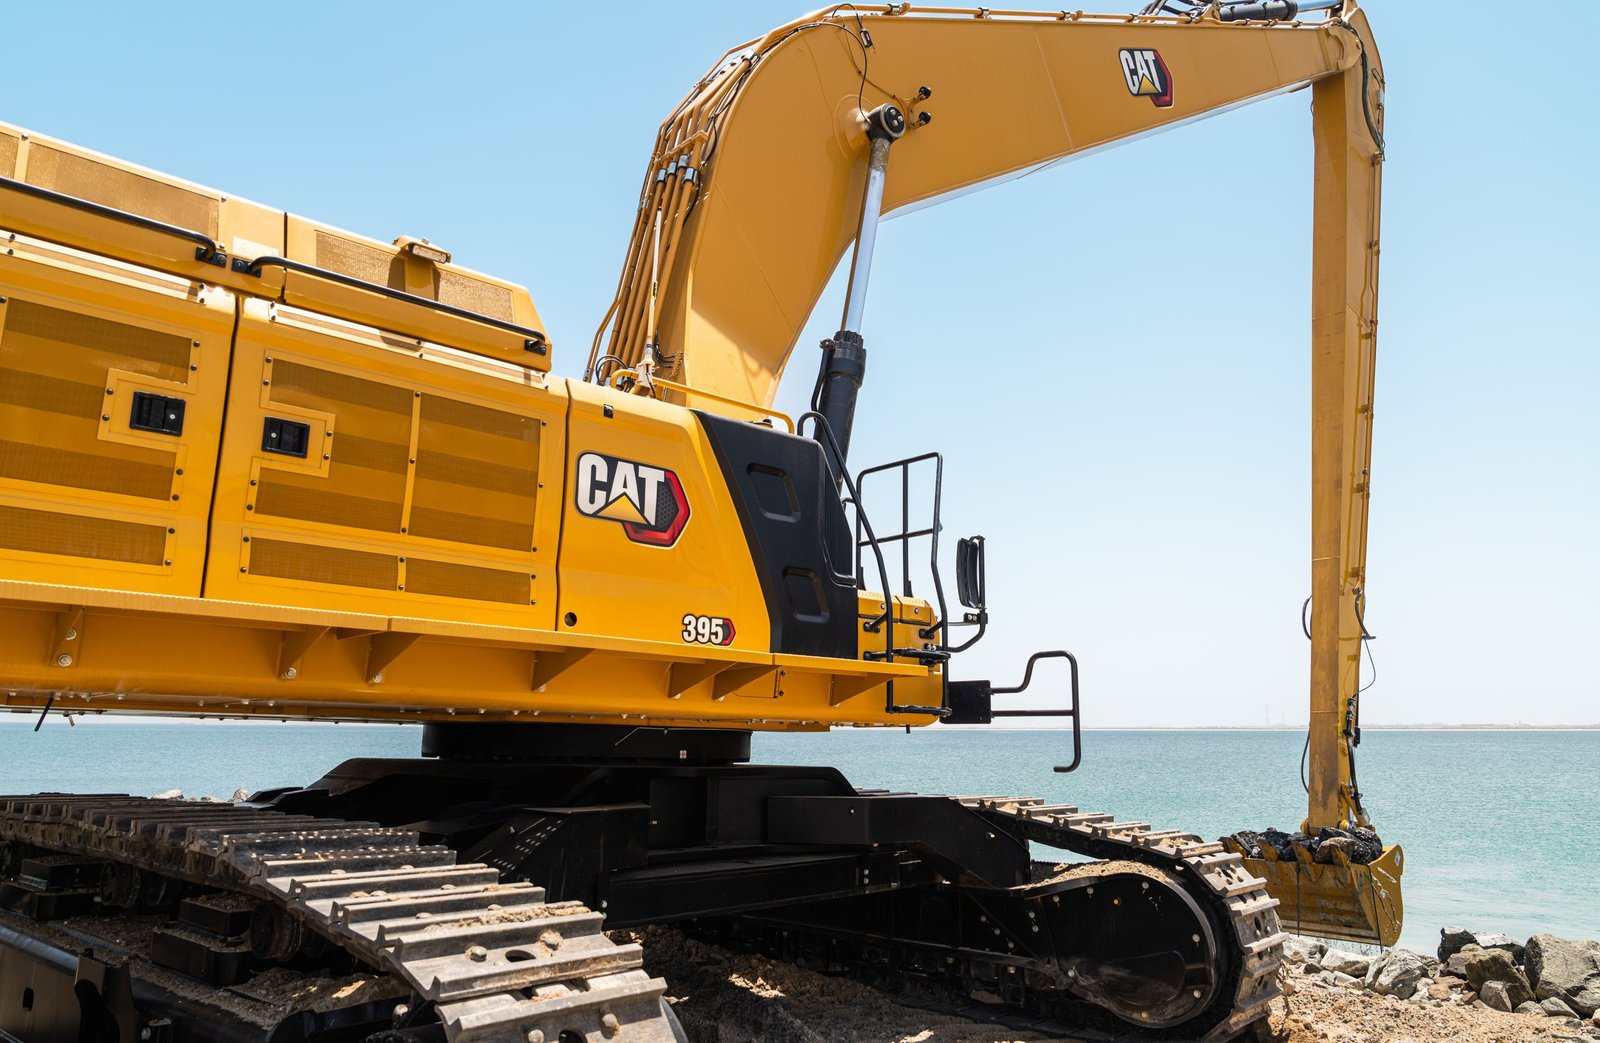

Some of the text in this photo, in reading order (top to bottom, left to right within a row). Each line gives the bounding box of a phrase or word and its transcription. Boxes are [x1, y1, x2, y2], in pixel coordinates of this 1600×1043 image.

[1120, 50, 1162, 94] CAT
[577, 453, 664, 526] CAT
[683, 615, 723, 644] 395
